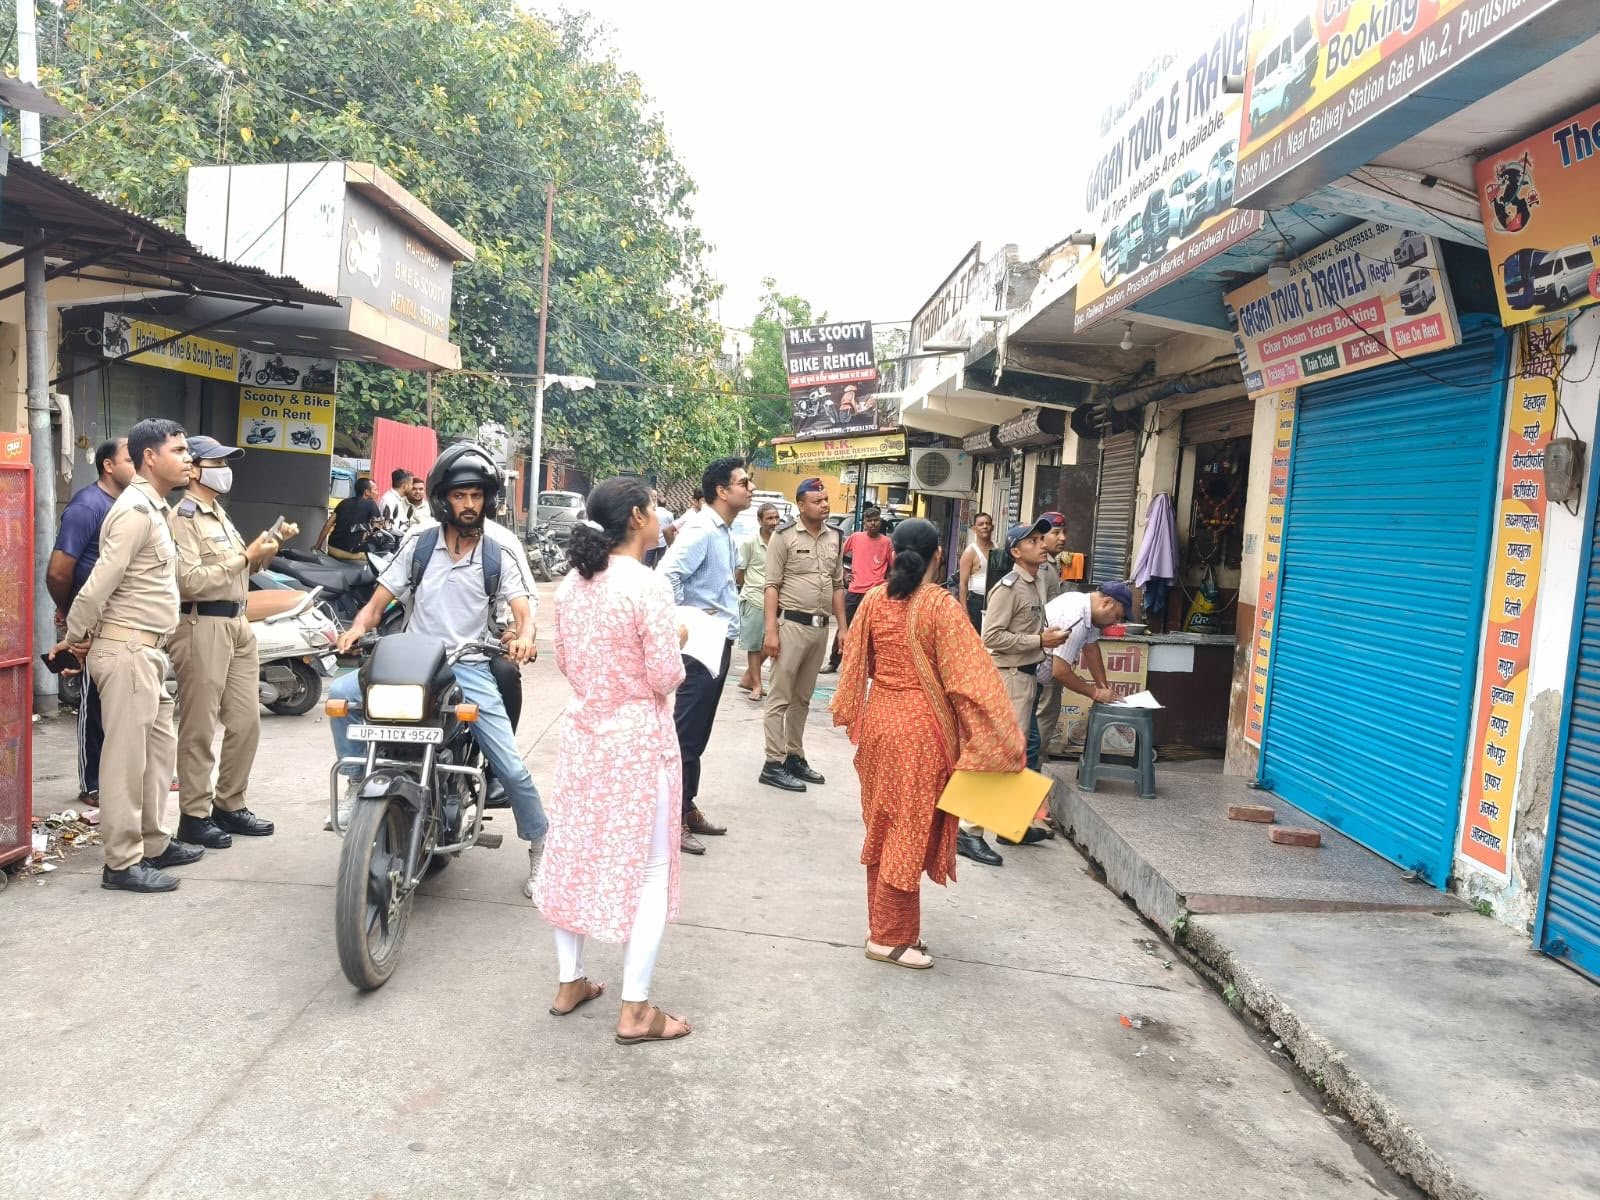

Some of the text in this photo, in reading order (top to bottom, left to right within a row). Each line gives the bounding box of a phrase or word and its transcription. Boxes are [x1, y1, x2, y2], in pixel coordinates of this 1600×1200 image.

[1326, 0, 1417, 79] Booking
[1240, 160, 1257, 187] Shop
[1287, 127, 1307, 158] Near
[1308, 101, 1345, 144] Railway
[1347, 75, 1384, 117] Station
[1387, 52, 1414, 90] Gate
[1458, 0, 1525, 45] Purusha
[1086, 136, 1124, 213] GAGAN
[1128, 96, 1164, 177] TOUR
[1168, 80, 1180, 140] &
[1186, 13, 1248, 123] TRAVE
[1112, 195, 1127, 220] Type
[1161, 152, 1177, 177] Are
[1178, 110, 1225, 162] Available.
[395, 261, 412, 286] BIKE
[420, 277, 446, 304] SCOOTY
[1086, 302, 1105, 321] Railway
[1160, 252, 1185, 280] Market,
[1188, 227, 1225, 260] Haridwar
[390, 290, 417, 320] RENTAL
[1239, 295, 1274, 337] GAGAN
[1271, 281, 1304, 325] TOUR
[1302, 277, 1313, 313] &
[1312, 252, 1367, 308] TRAVELS
[790, 323, 866, 344] N.K. SCOOTY
[1263, 305, 1377, 356] Char Dham Yatra Booking
[1396, 323, 1439, 345] Bike On Rent
[170, 340, 185, 359] Bike
[193, 343, 212, 370] Scooty
[215, 349, 234, 370] Rental
[827, 343, 833, 353] &
[790, 352, 872, 373] BIKE RENTAL
[1317, 352, 1335, 367] Ticket
[244, 390, 330, 407] Scooty & Bike
[262, 407, 311, 420] On Rent
[1523, 421, 1540, 443] मसूरी
[824, 440, 853, 449] N.K.
[1504, 599, 1521, 616] दिल्ली
[1500, 630, 1519, 645] आगरा
[1498, 659, 1514, 677] मथुरा
[1490, 716, 1509, 736] जयपुर
[1486, 742, 1506, 766] जोधपुर
[1484, 773, 1501, 791] पुष्कर
[1480, 800, 1498, 820] अजमेर
[1471, 826, 1501, 850] अहमदाबाद
